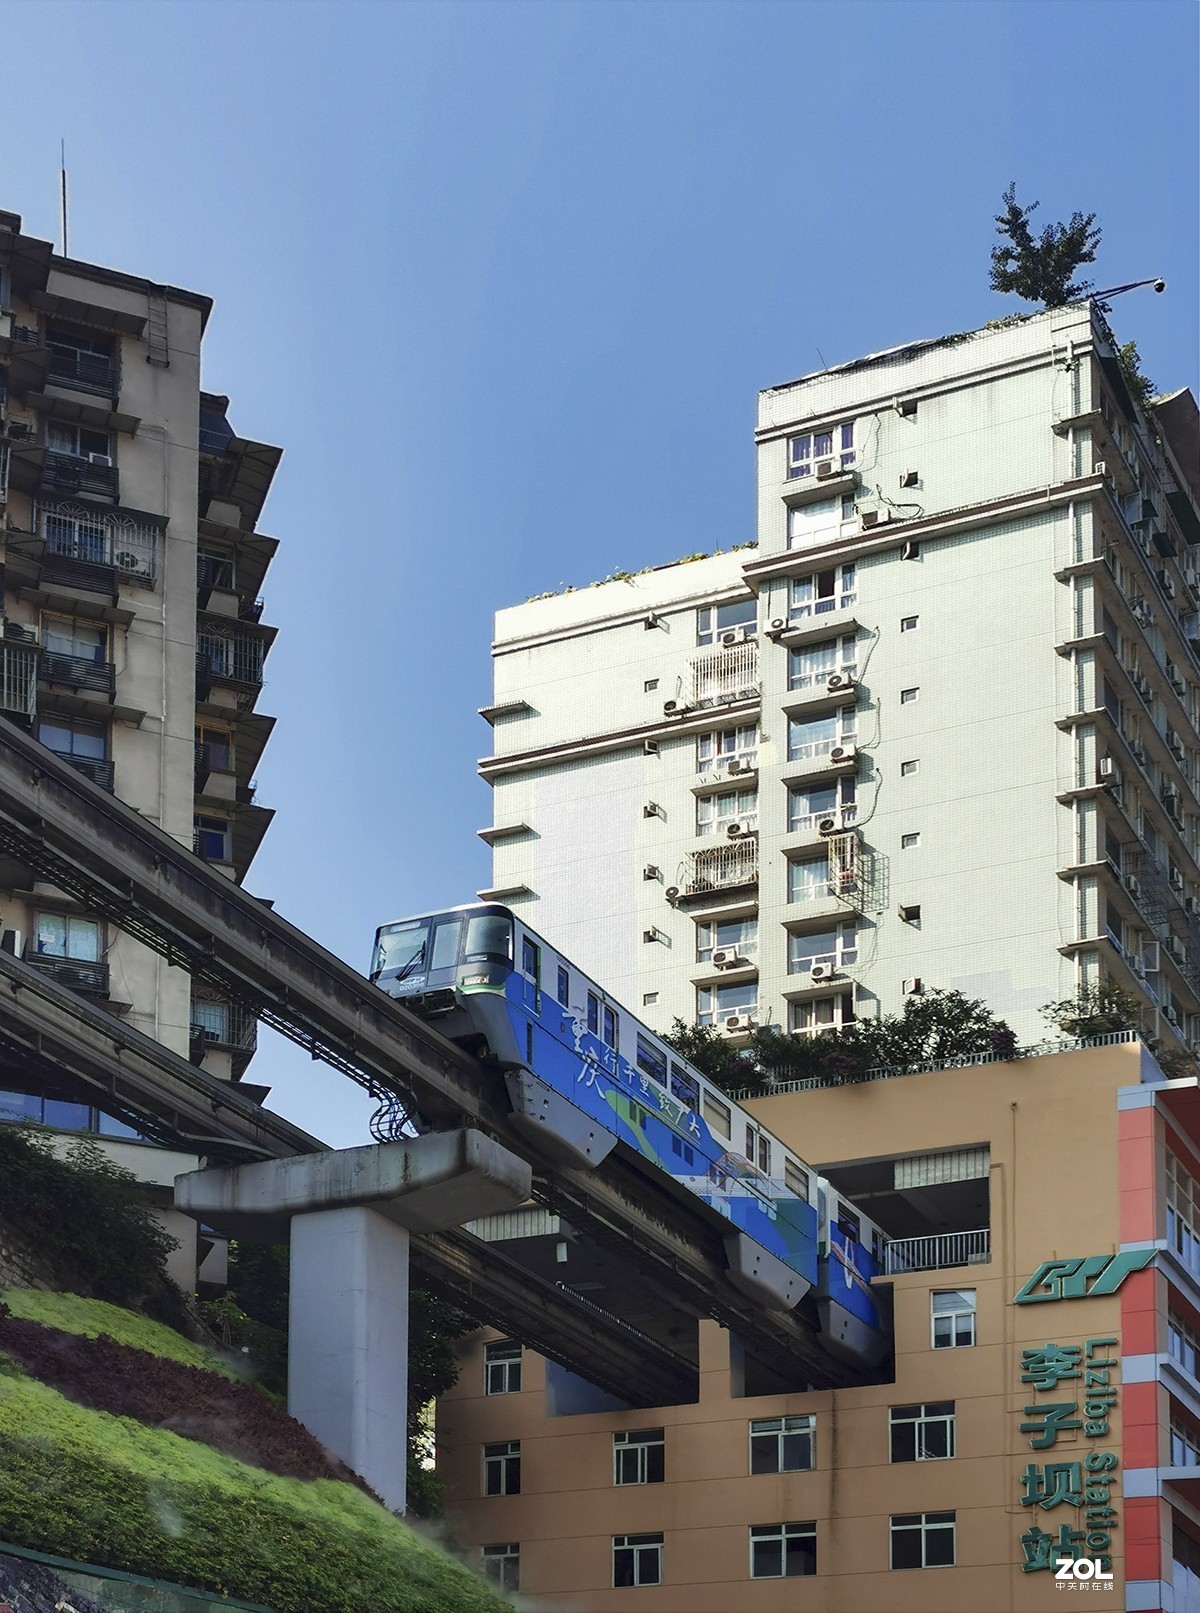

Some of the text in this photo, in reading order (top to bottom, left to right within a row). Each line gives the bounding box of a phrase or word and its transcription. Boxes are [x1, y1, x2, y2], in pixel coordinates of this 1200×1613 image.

[1019, 1343, 1085, 1574] 李子坝站
[1084, 1337, 1119, 1437] Liziba
